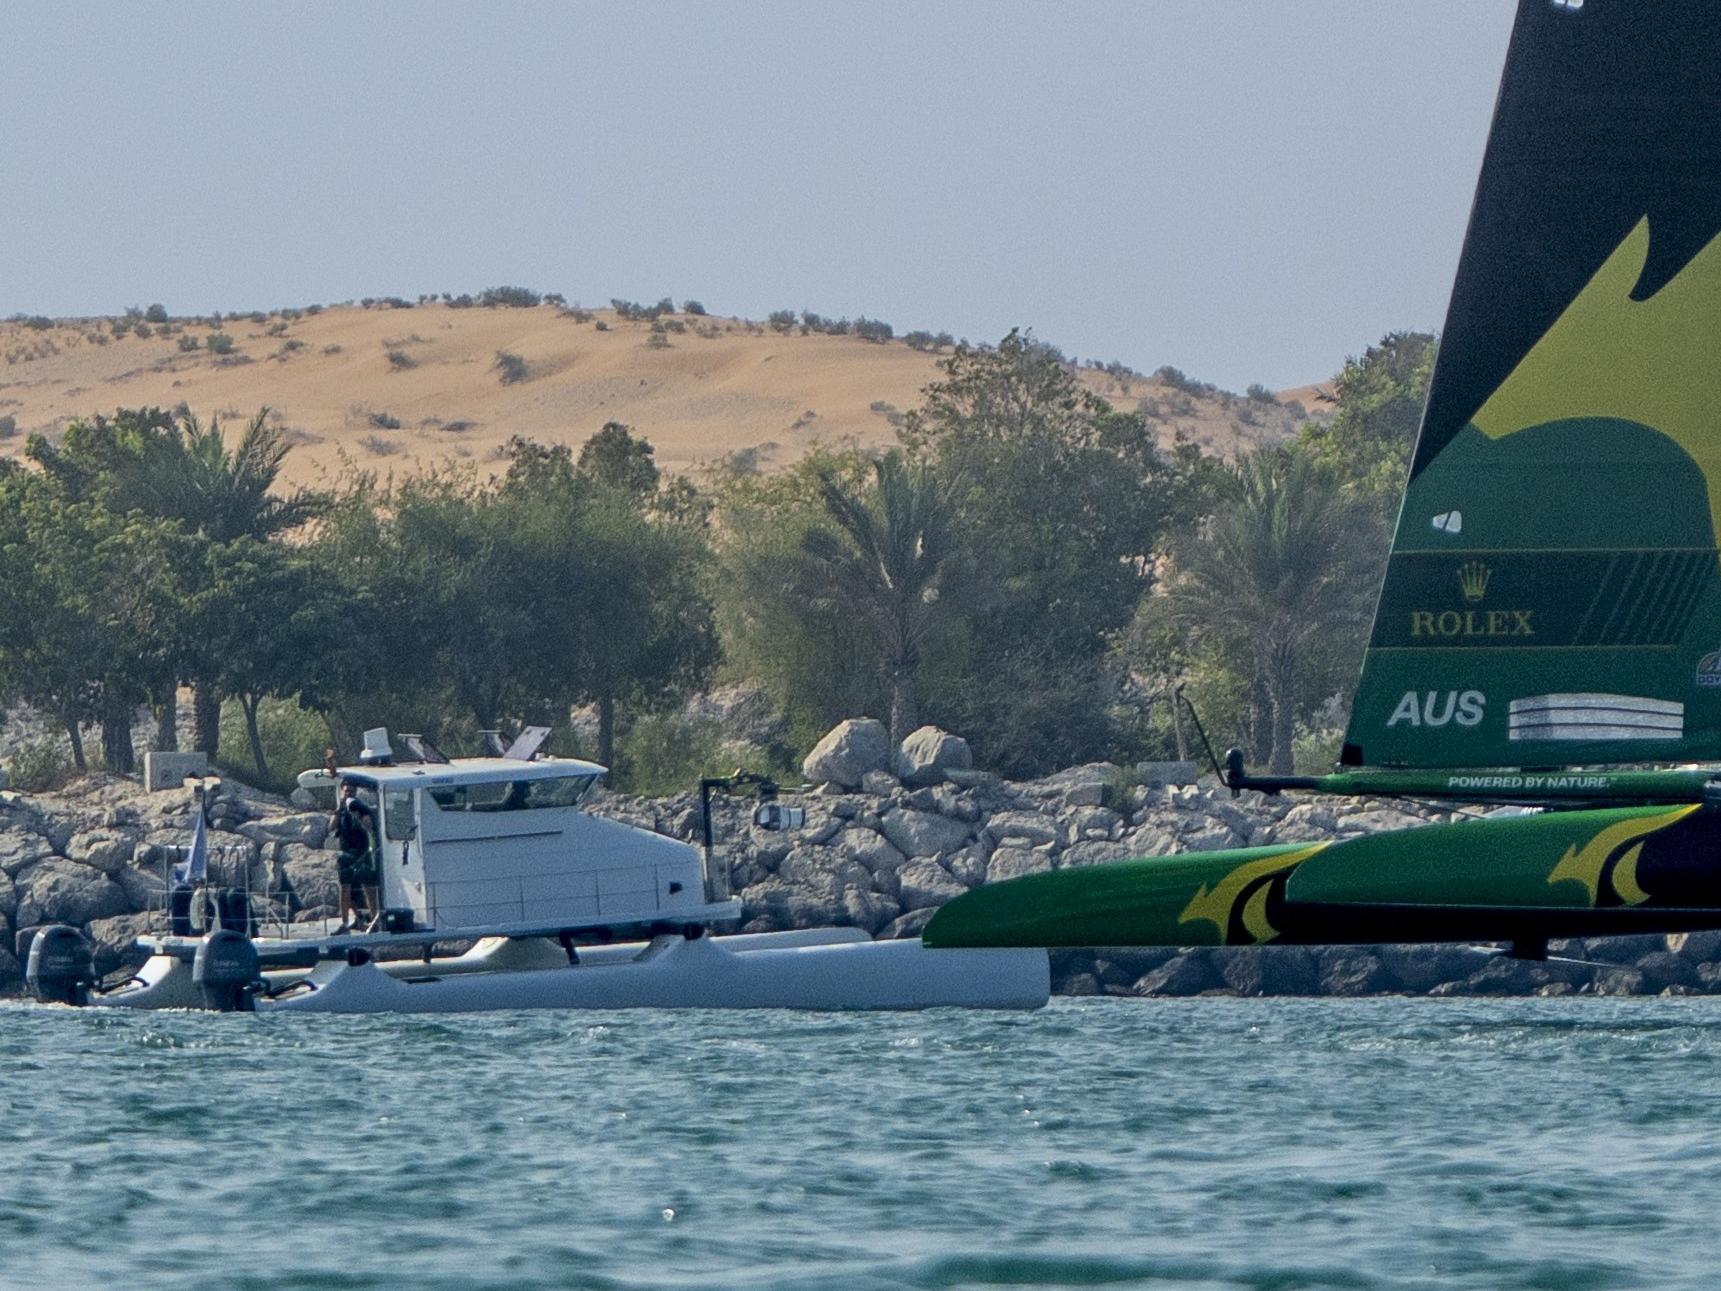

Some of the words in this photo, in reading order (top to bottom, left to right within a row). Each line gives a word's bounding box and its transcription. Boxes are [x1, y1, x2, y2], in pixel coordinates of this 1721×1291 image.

[1412, 611, 1535, 636] ROLEX
[1387, 690, 1486, 727] AUS
[1449, 776, 1521, 788] POWERED
[1523, 776, 1546, 787] BY
